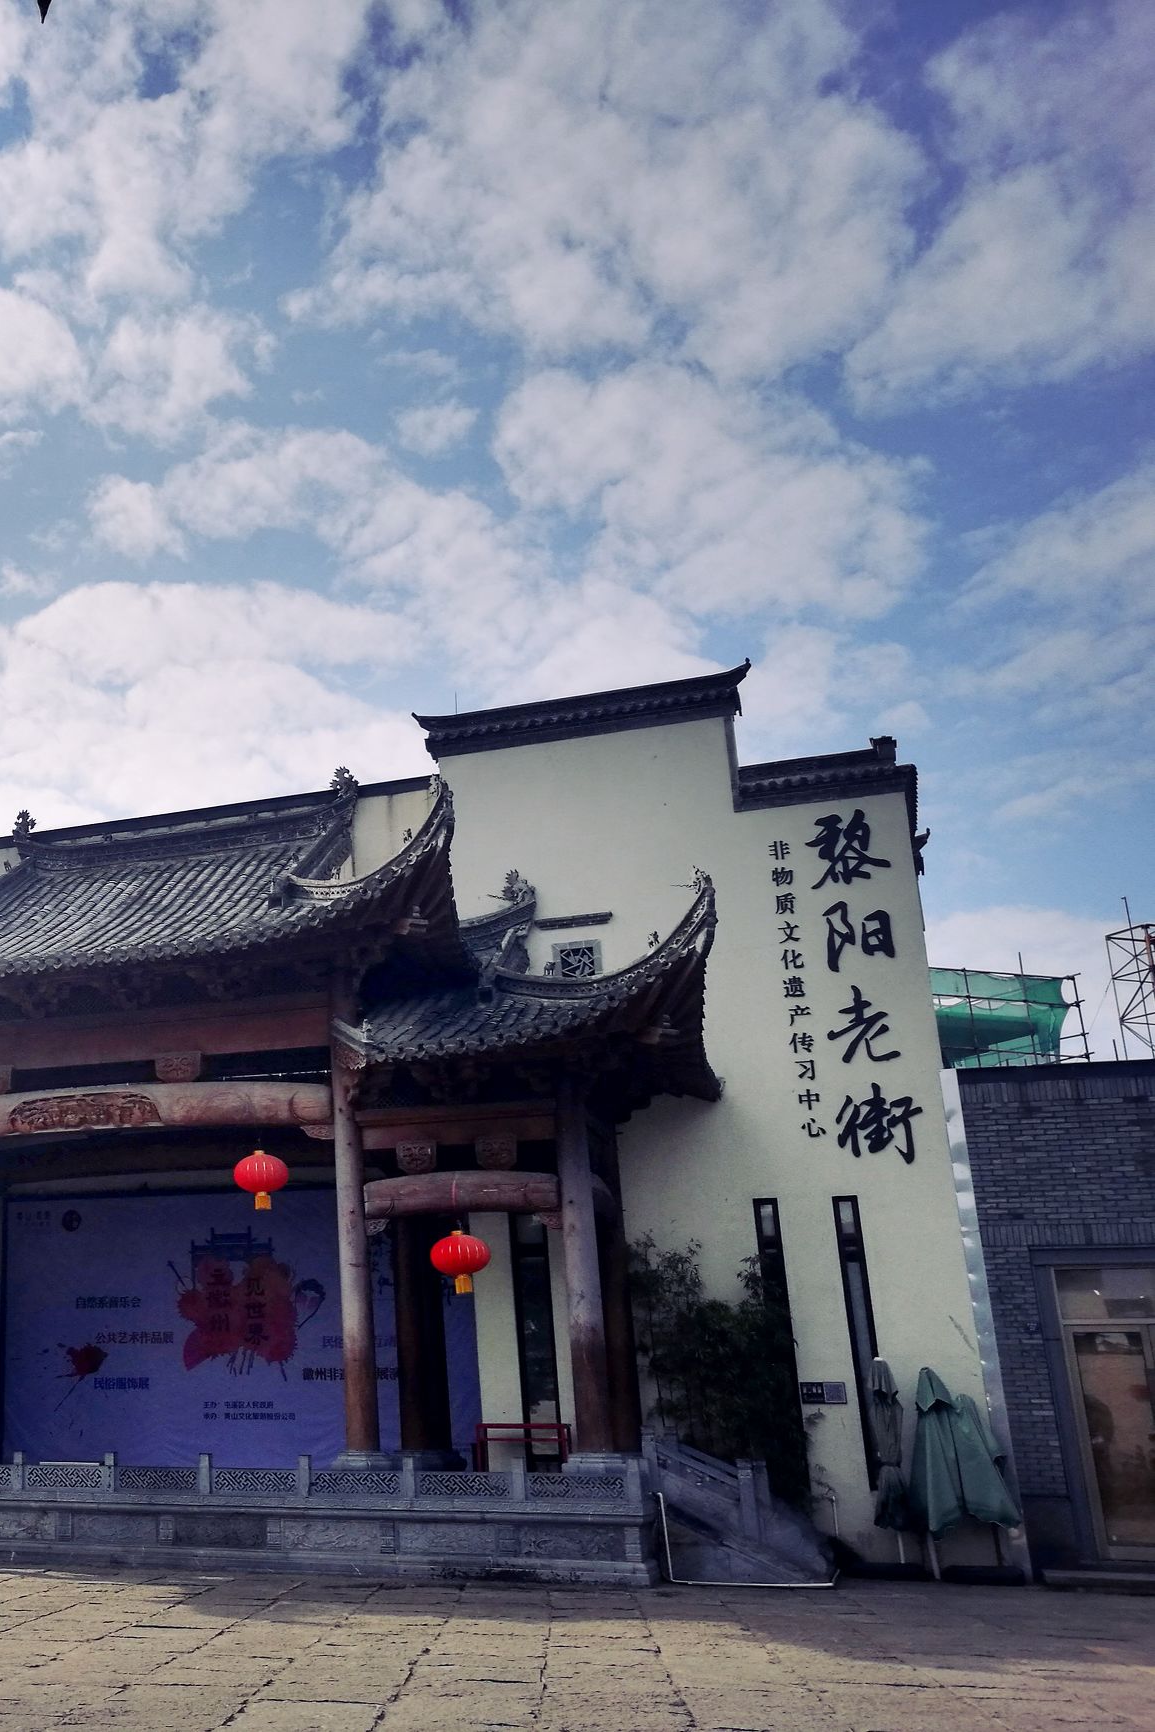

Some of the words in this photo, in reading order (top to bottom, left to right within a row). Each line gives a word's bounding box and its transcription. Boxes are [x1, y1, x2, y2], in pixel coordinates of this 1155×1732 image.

[768, 839, 826, 1139] 非物质文化遗产传习中心
[804, 808, 923, 1165] 黎阳老街
[94, 1331, 175, 1345] 公共艺术作品展
